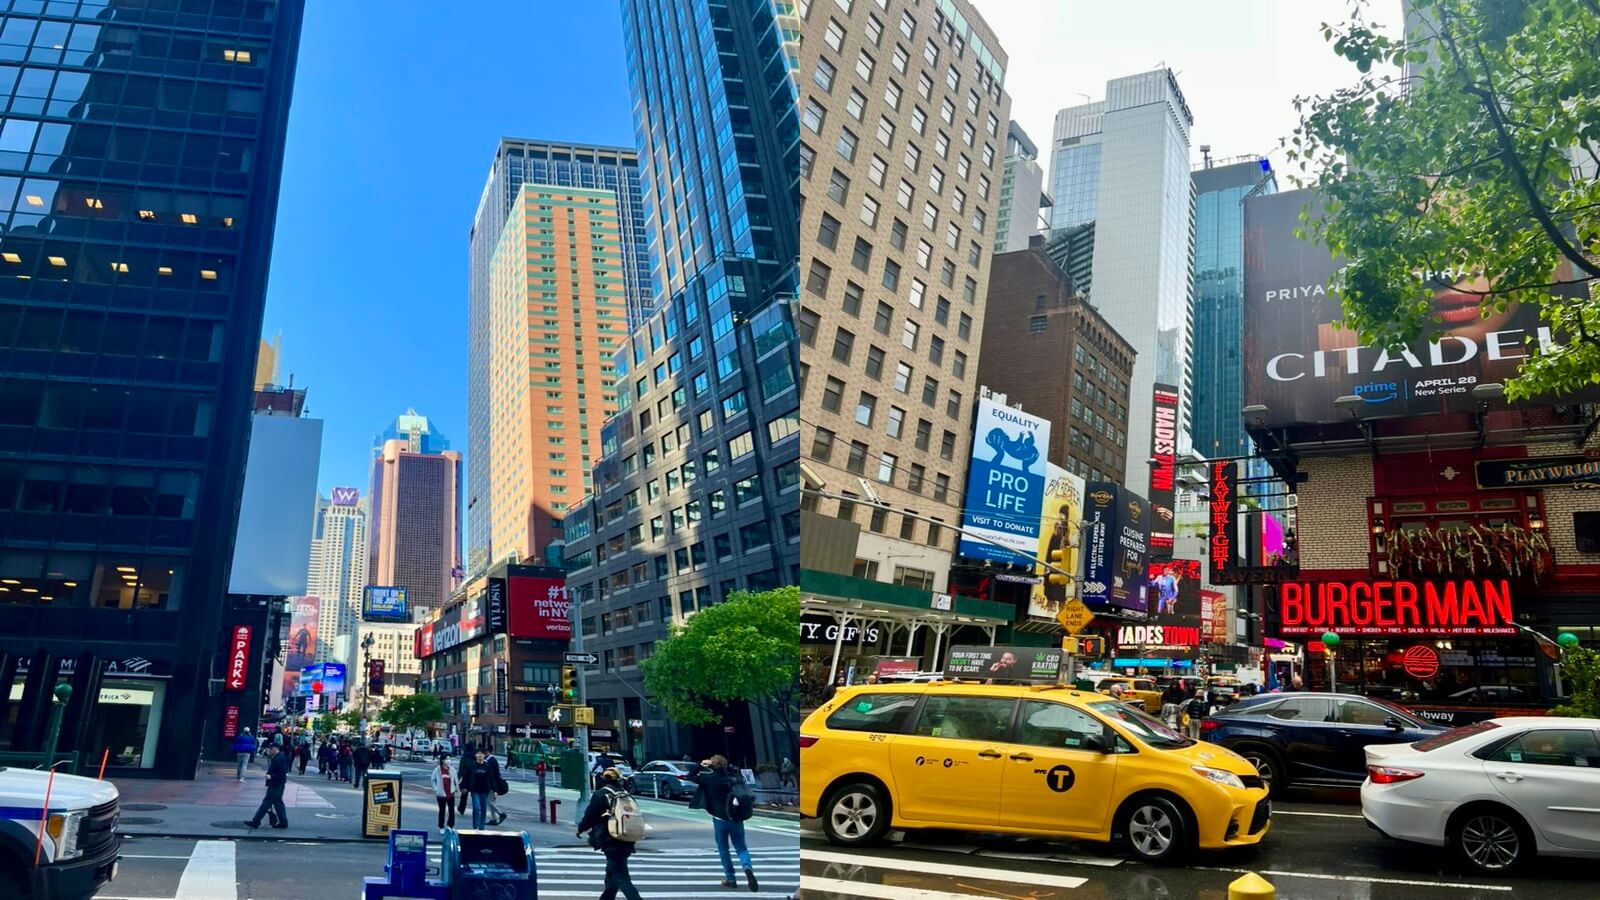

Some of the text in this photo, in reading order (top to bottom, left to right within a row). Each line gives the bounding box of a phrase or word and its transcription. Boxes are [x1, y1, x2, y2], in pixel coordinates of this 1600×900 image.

[1266, 283, 1346, 302] PRIYA
[1354, 380, 1397, 396] prime
[1415, 375, 1477, 389] APRIL 28
[1414, 385, 1467, 397] New Series
[991, 408, 1040, 431] EQUALITY
[988, 469, 1029, 493] PRO
[338, 489, 356, 502] W
[985, 490, 1027, 514] LIFE
[972, 515, 1035, 535] VISIT TO DONATE
[1122, 526, 1144, 543] CUISINE
[1119, 535, 1147, 554] PREPARED
[1126, 550, 1139, 561] FOR
[547, 585, 569, 600] #1
[534, 599, 570, 610] netwo
[1281, 579, 1514, 626] BURGER MAN
[539, 608, 550, 617] in
[545, 623, 571, 632] verizo
[433, 621, 462, 653] verizon
[232, 640, 246, 678] PARK
[952, 651, 965, 659] YOUR
[980, 652, 993, 660] TIME
[1046, 654, 1060, 662] CBD
[1032, 661, 1059, 669] KRATOM
[1415, 710, 1455, 722] bway
[1053, 770, 1070, 789] T
